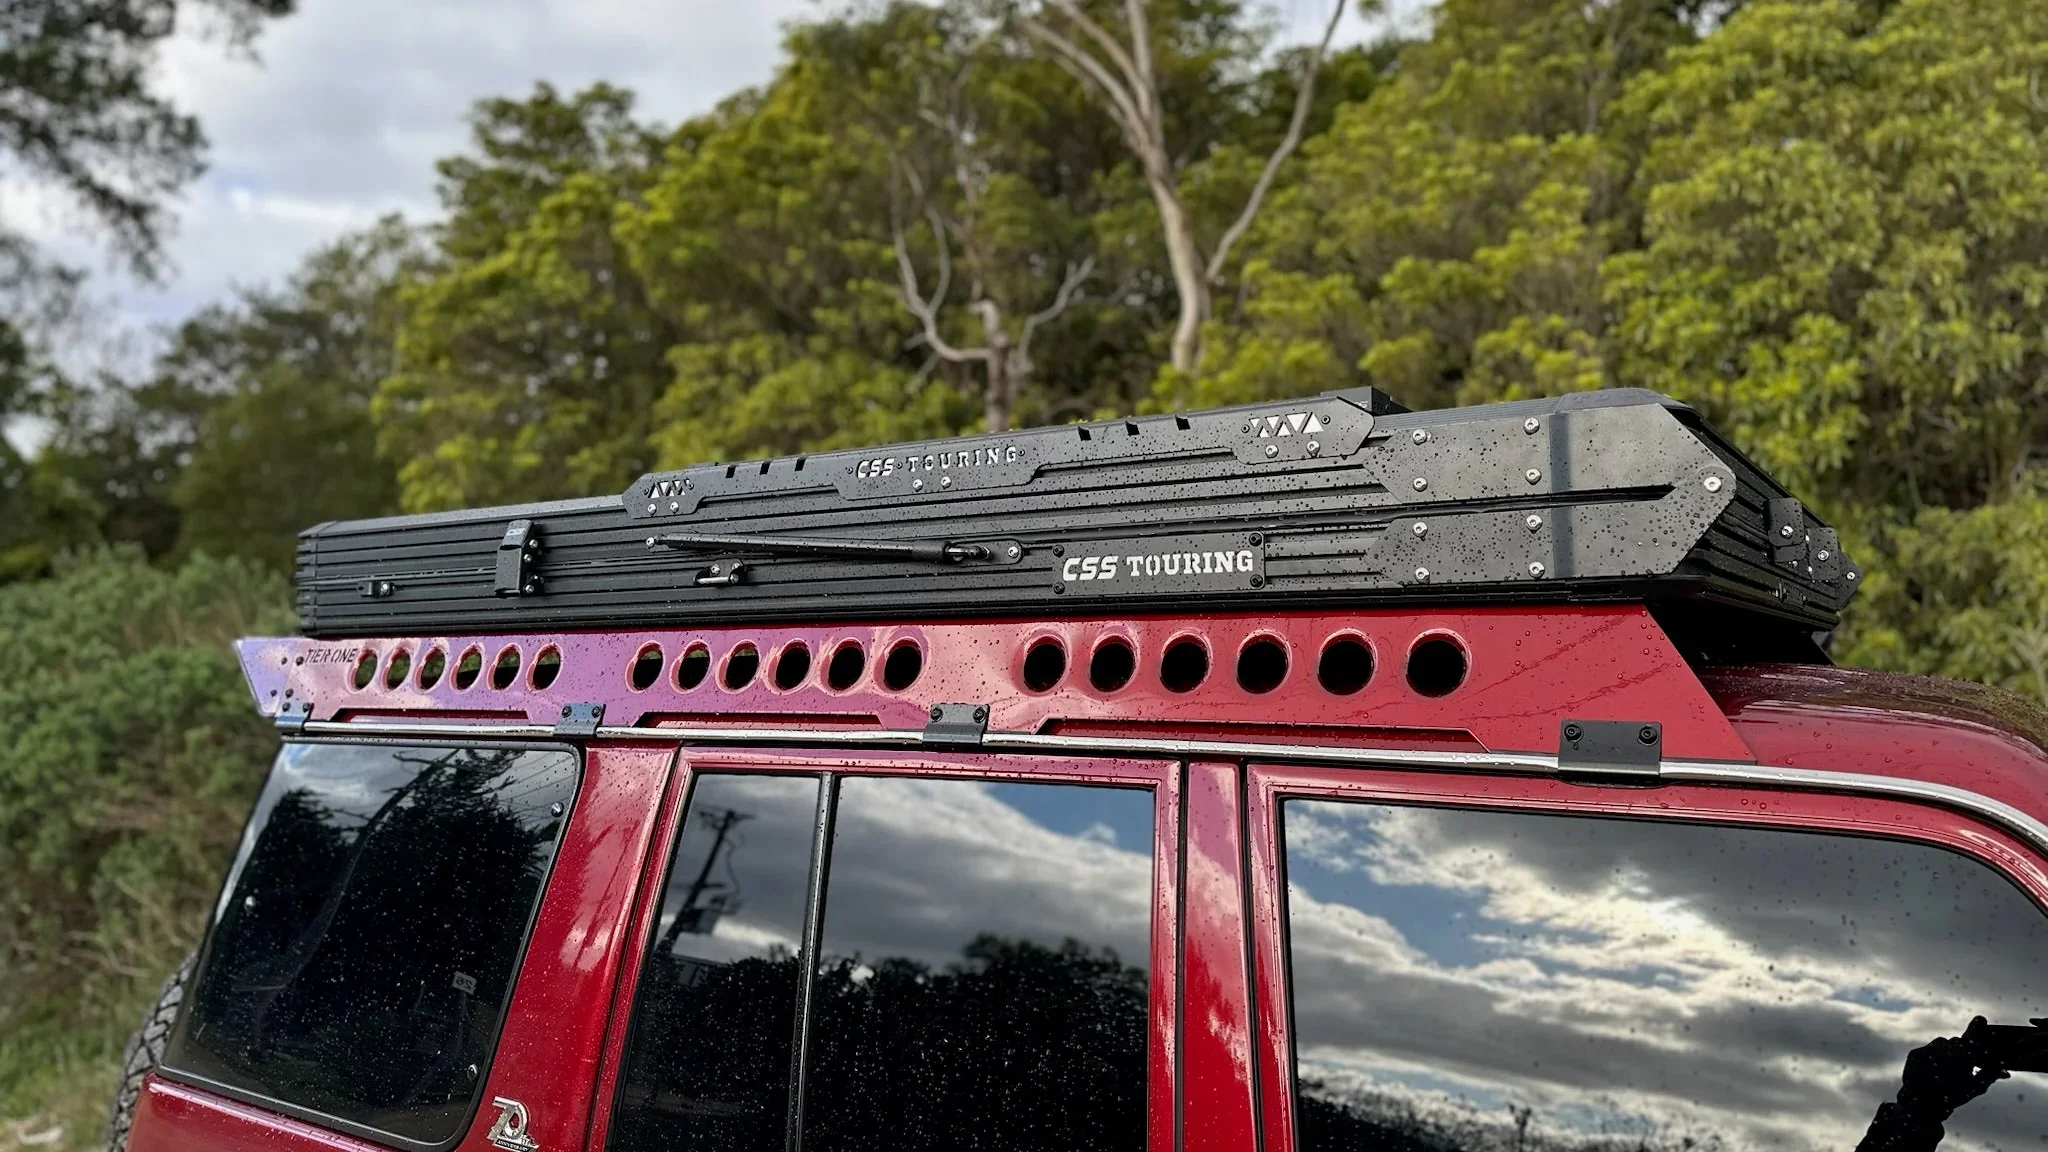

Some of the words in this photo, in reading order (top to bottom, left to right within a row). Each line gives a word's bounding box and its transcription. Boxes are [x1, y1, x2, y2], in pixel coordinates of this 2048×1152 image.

[857, 457, 895, 478] CSS
[907, 446, 1017, 472] TOURING
[1063, 555, 1118, 581] CSS
[1126, 550, 1253, 576] TOURING
[331, 648, 358, 663] ONE
